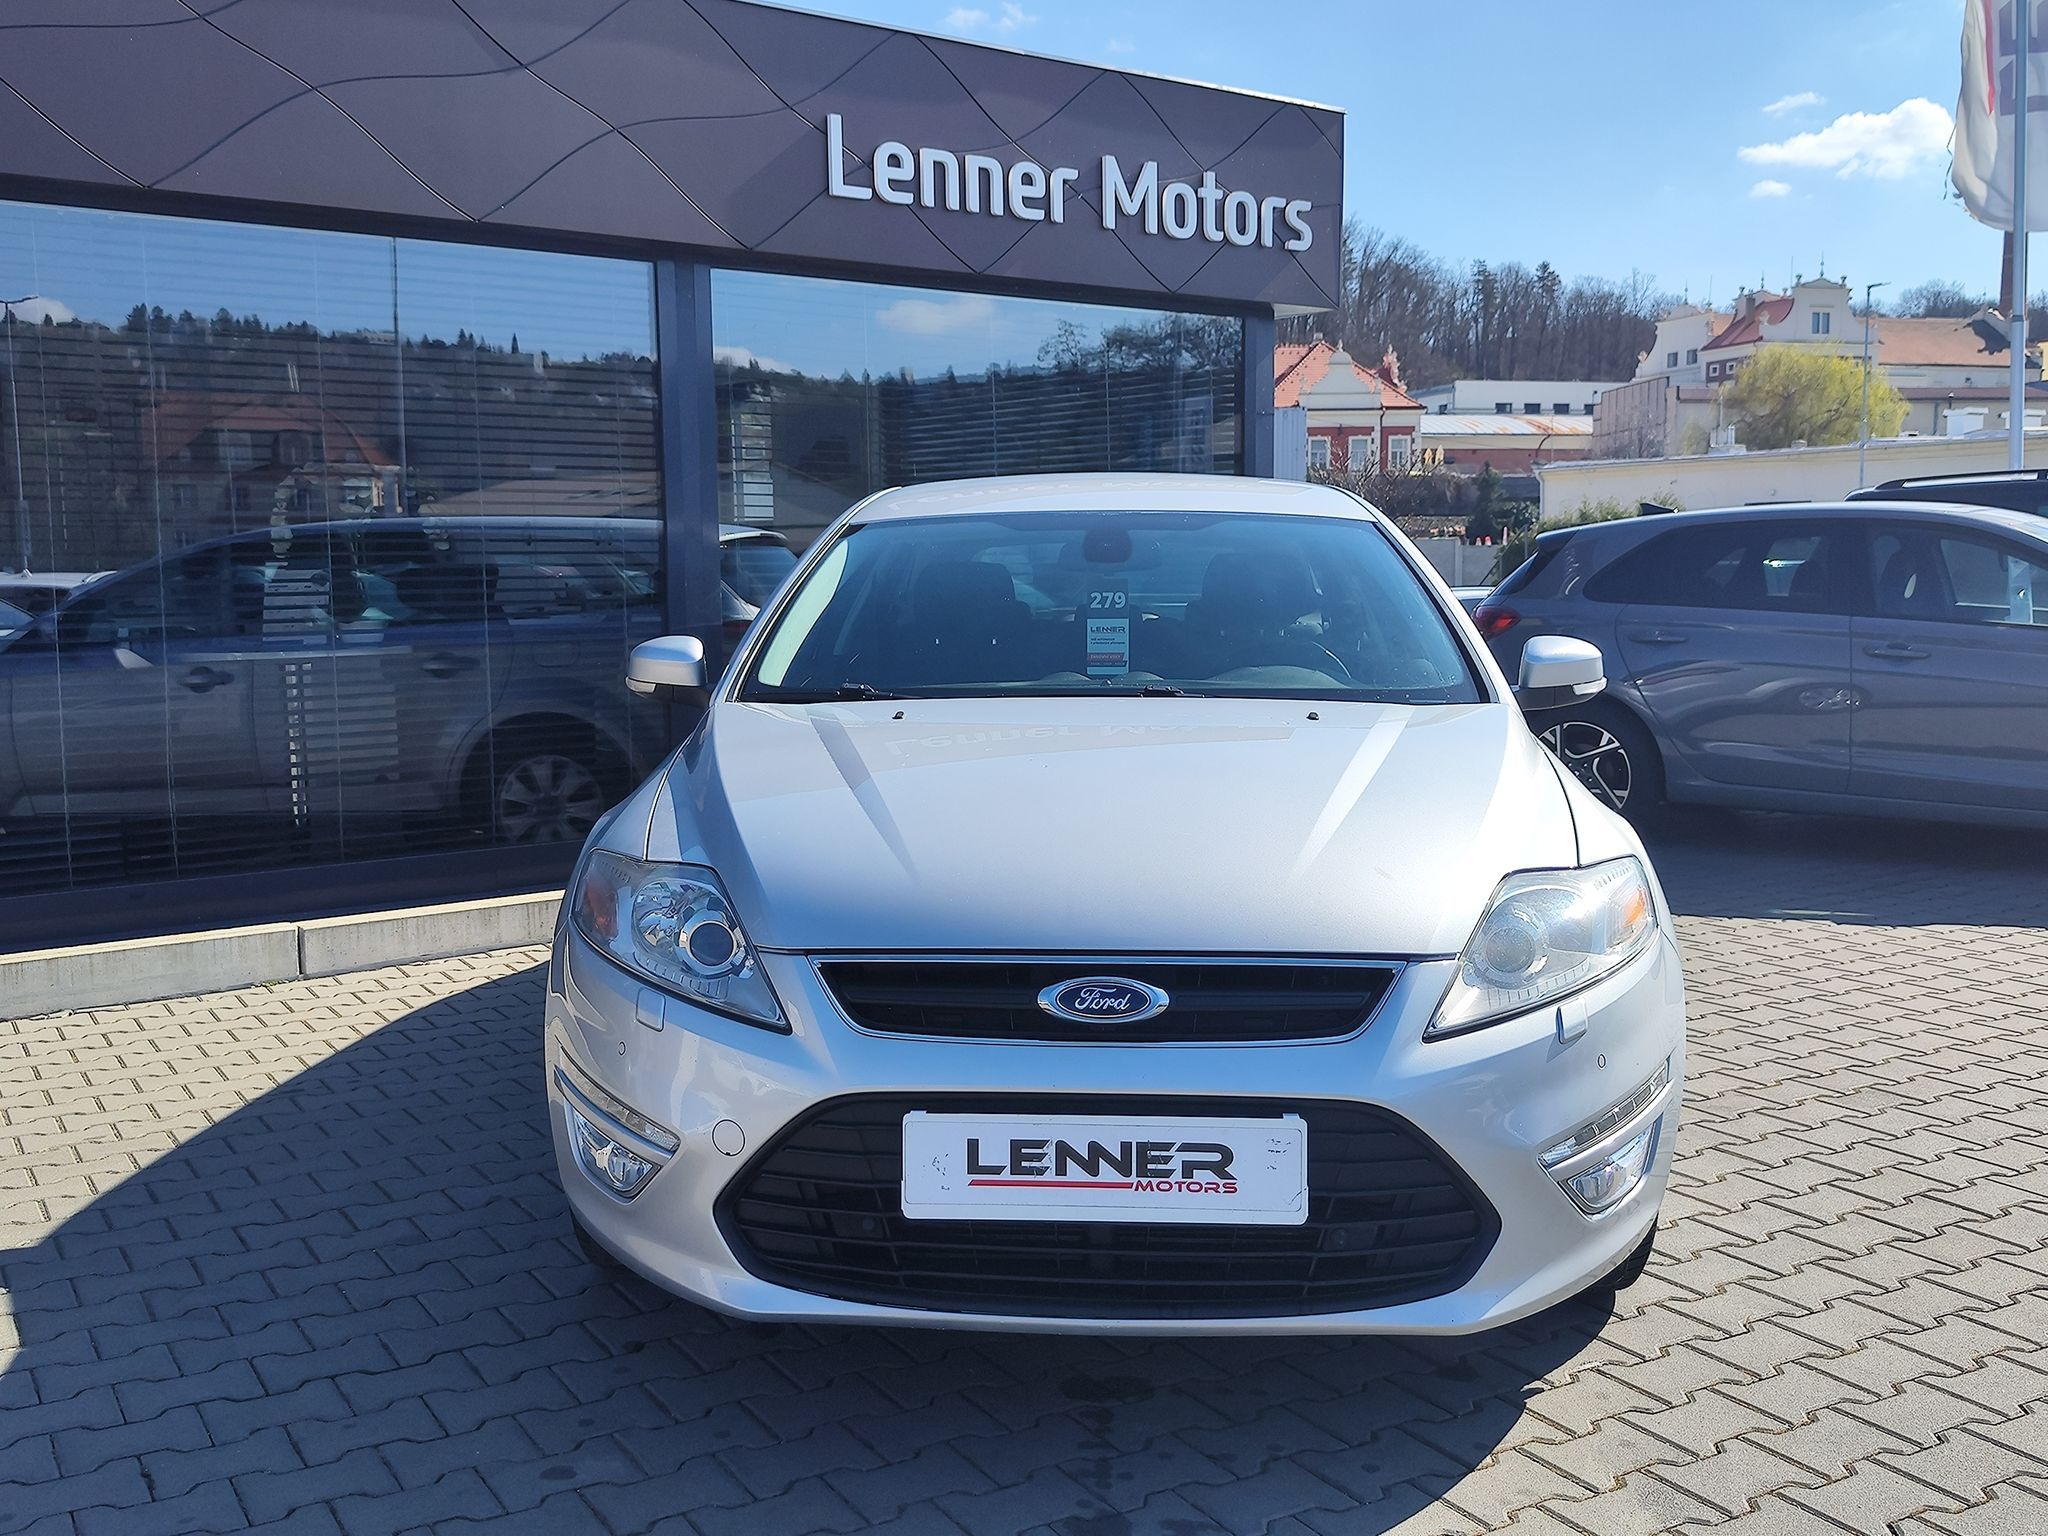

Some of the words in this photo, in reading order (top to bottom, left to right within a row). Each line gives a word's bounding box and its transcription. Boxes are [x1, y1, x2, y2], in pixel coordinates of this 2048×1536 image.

[827, 113, 1079, 224] Lenner
[1101, 154, 1313, 252] Motors
[1090, 591, 1126, 609] 279
[1075, 986, 1131, 1011] Ford
[966, 1137, 1238, 1180] LENNER
[1133, 1180, 1238, 1194] MOTORS
